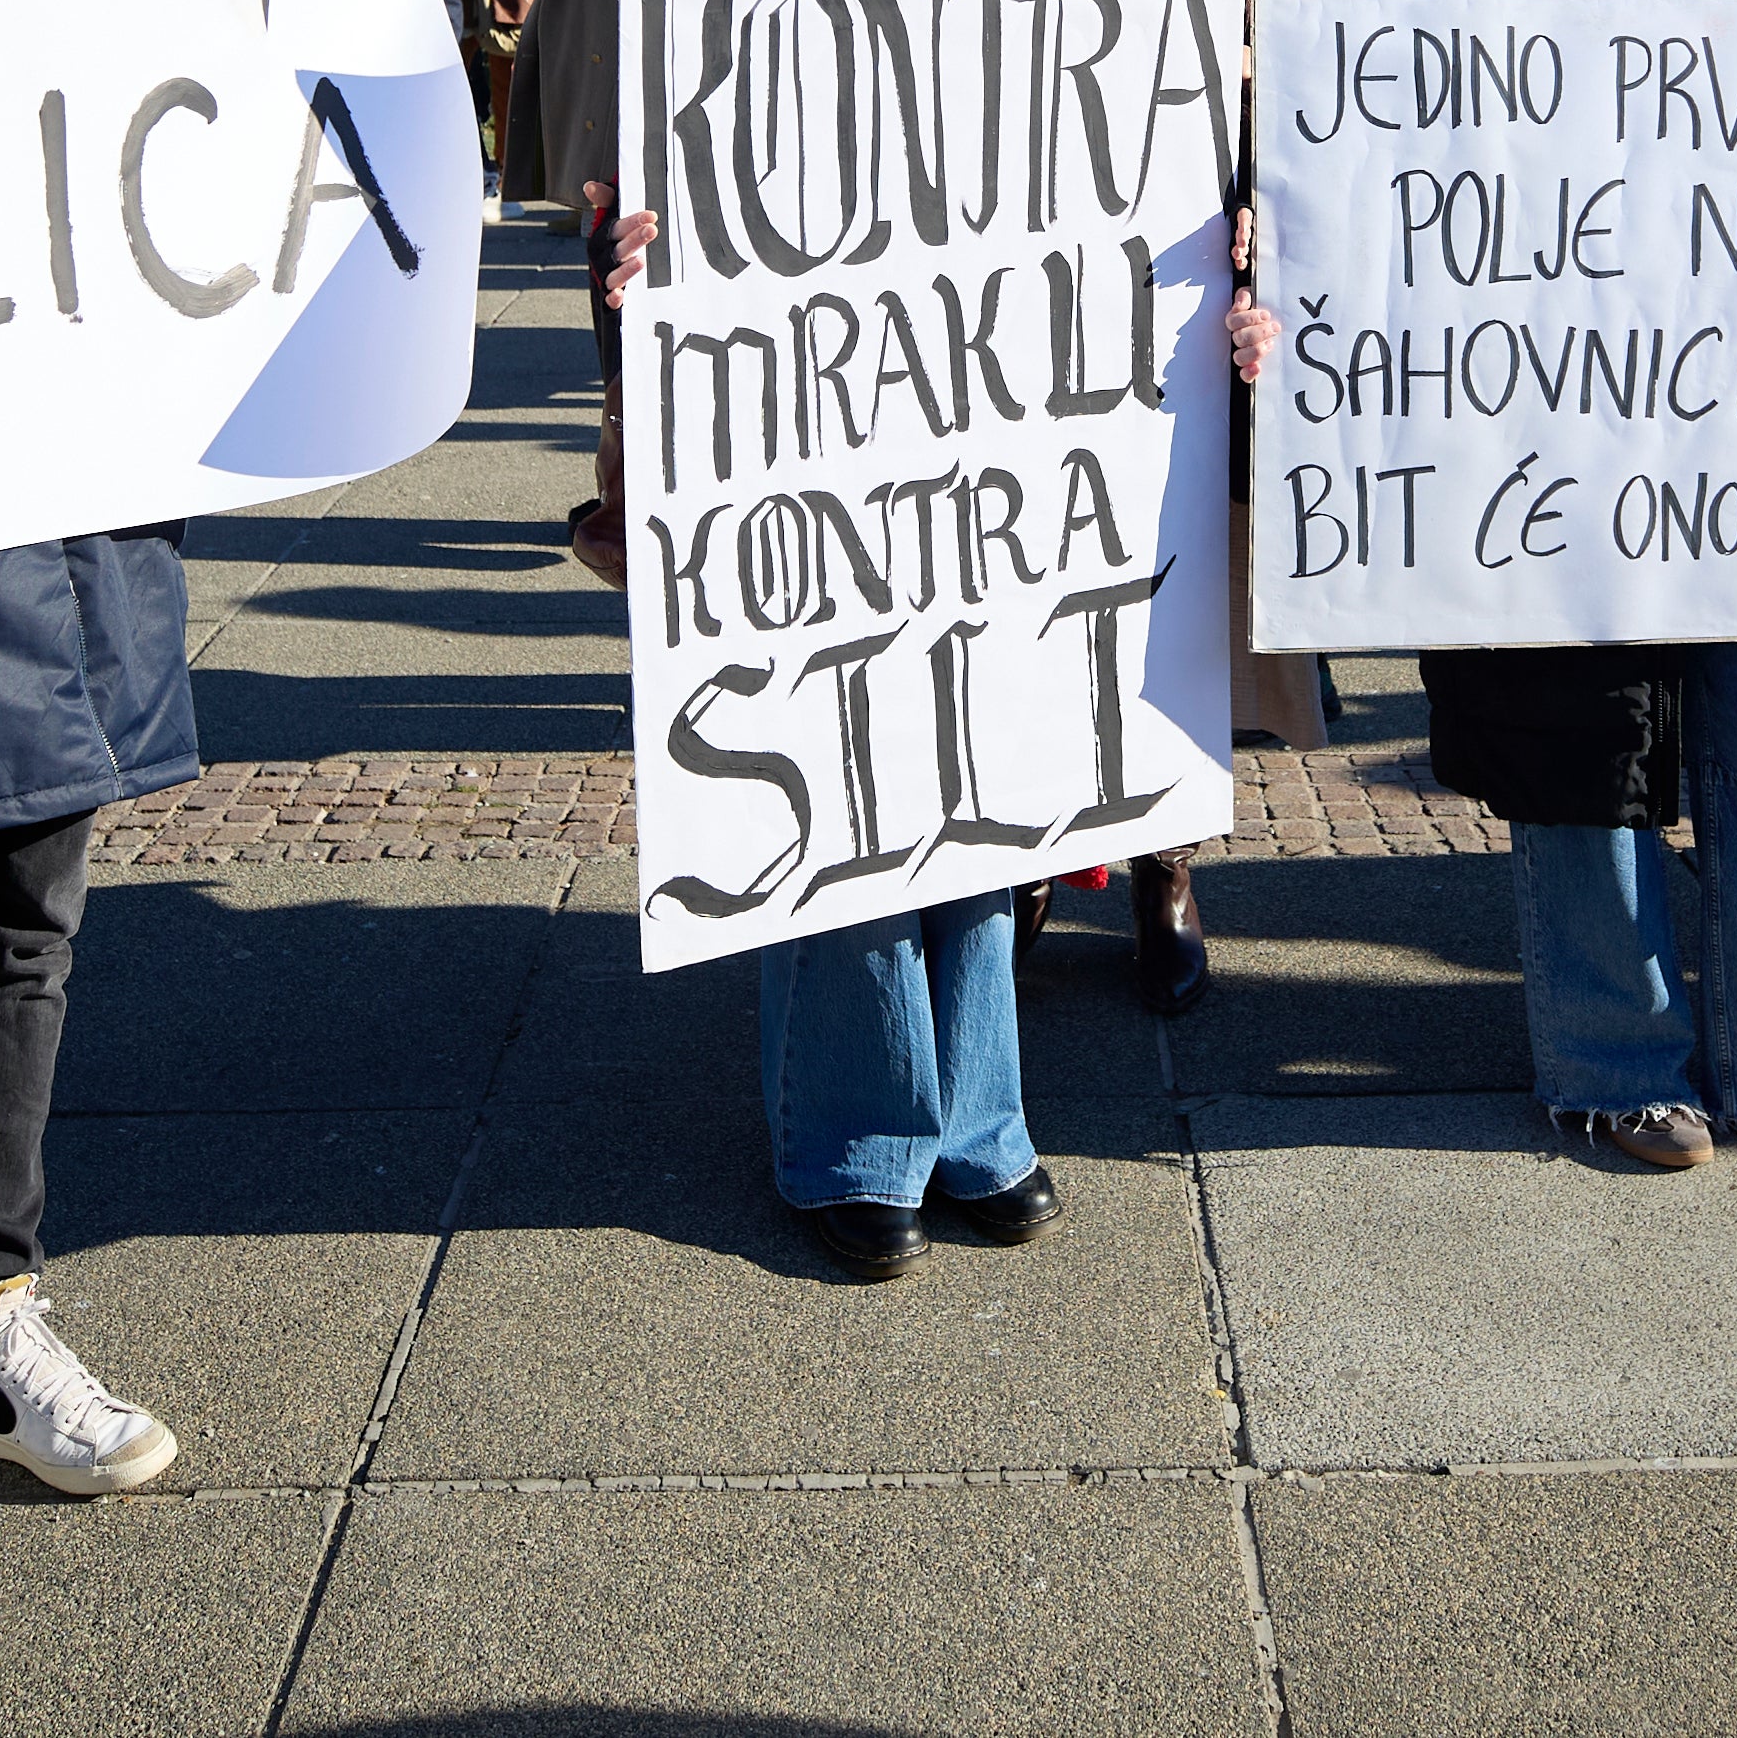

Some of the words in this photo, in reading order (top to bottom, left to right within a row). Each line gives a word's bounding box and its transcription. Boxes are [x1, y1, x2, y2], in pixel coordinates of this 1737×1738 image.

[1295, 21, 1564, 144] JEDINO
[1390, 169, 1628, 288] POLJE
[645, 447, 1132, 649] KONTRA
[1283, 463, 1436, 580] BIT
[1474, 451, 1580, 570] ĆE
[644, 553, 1183, 919] SILI
